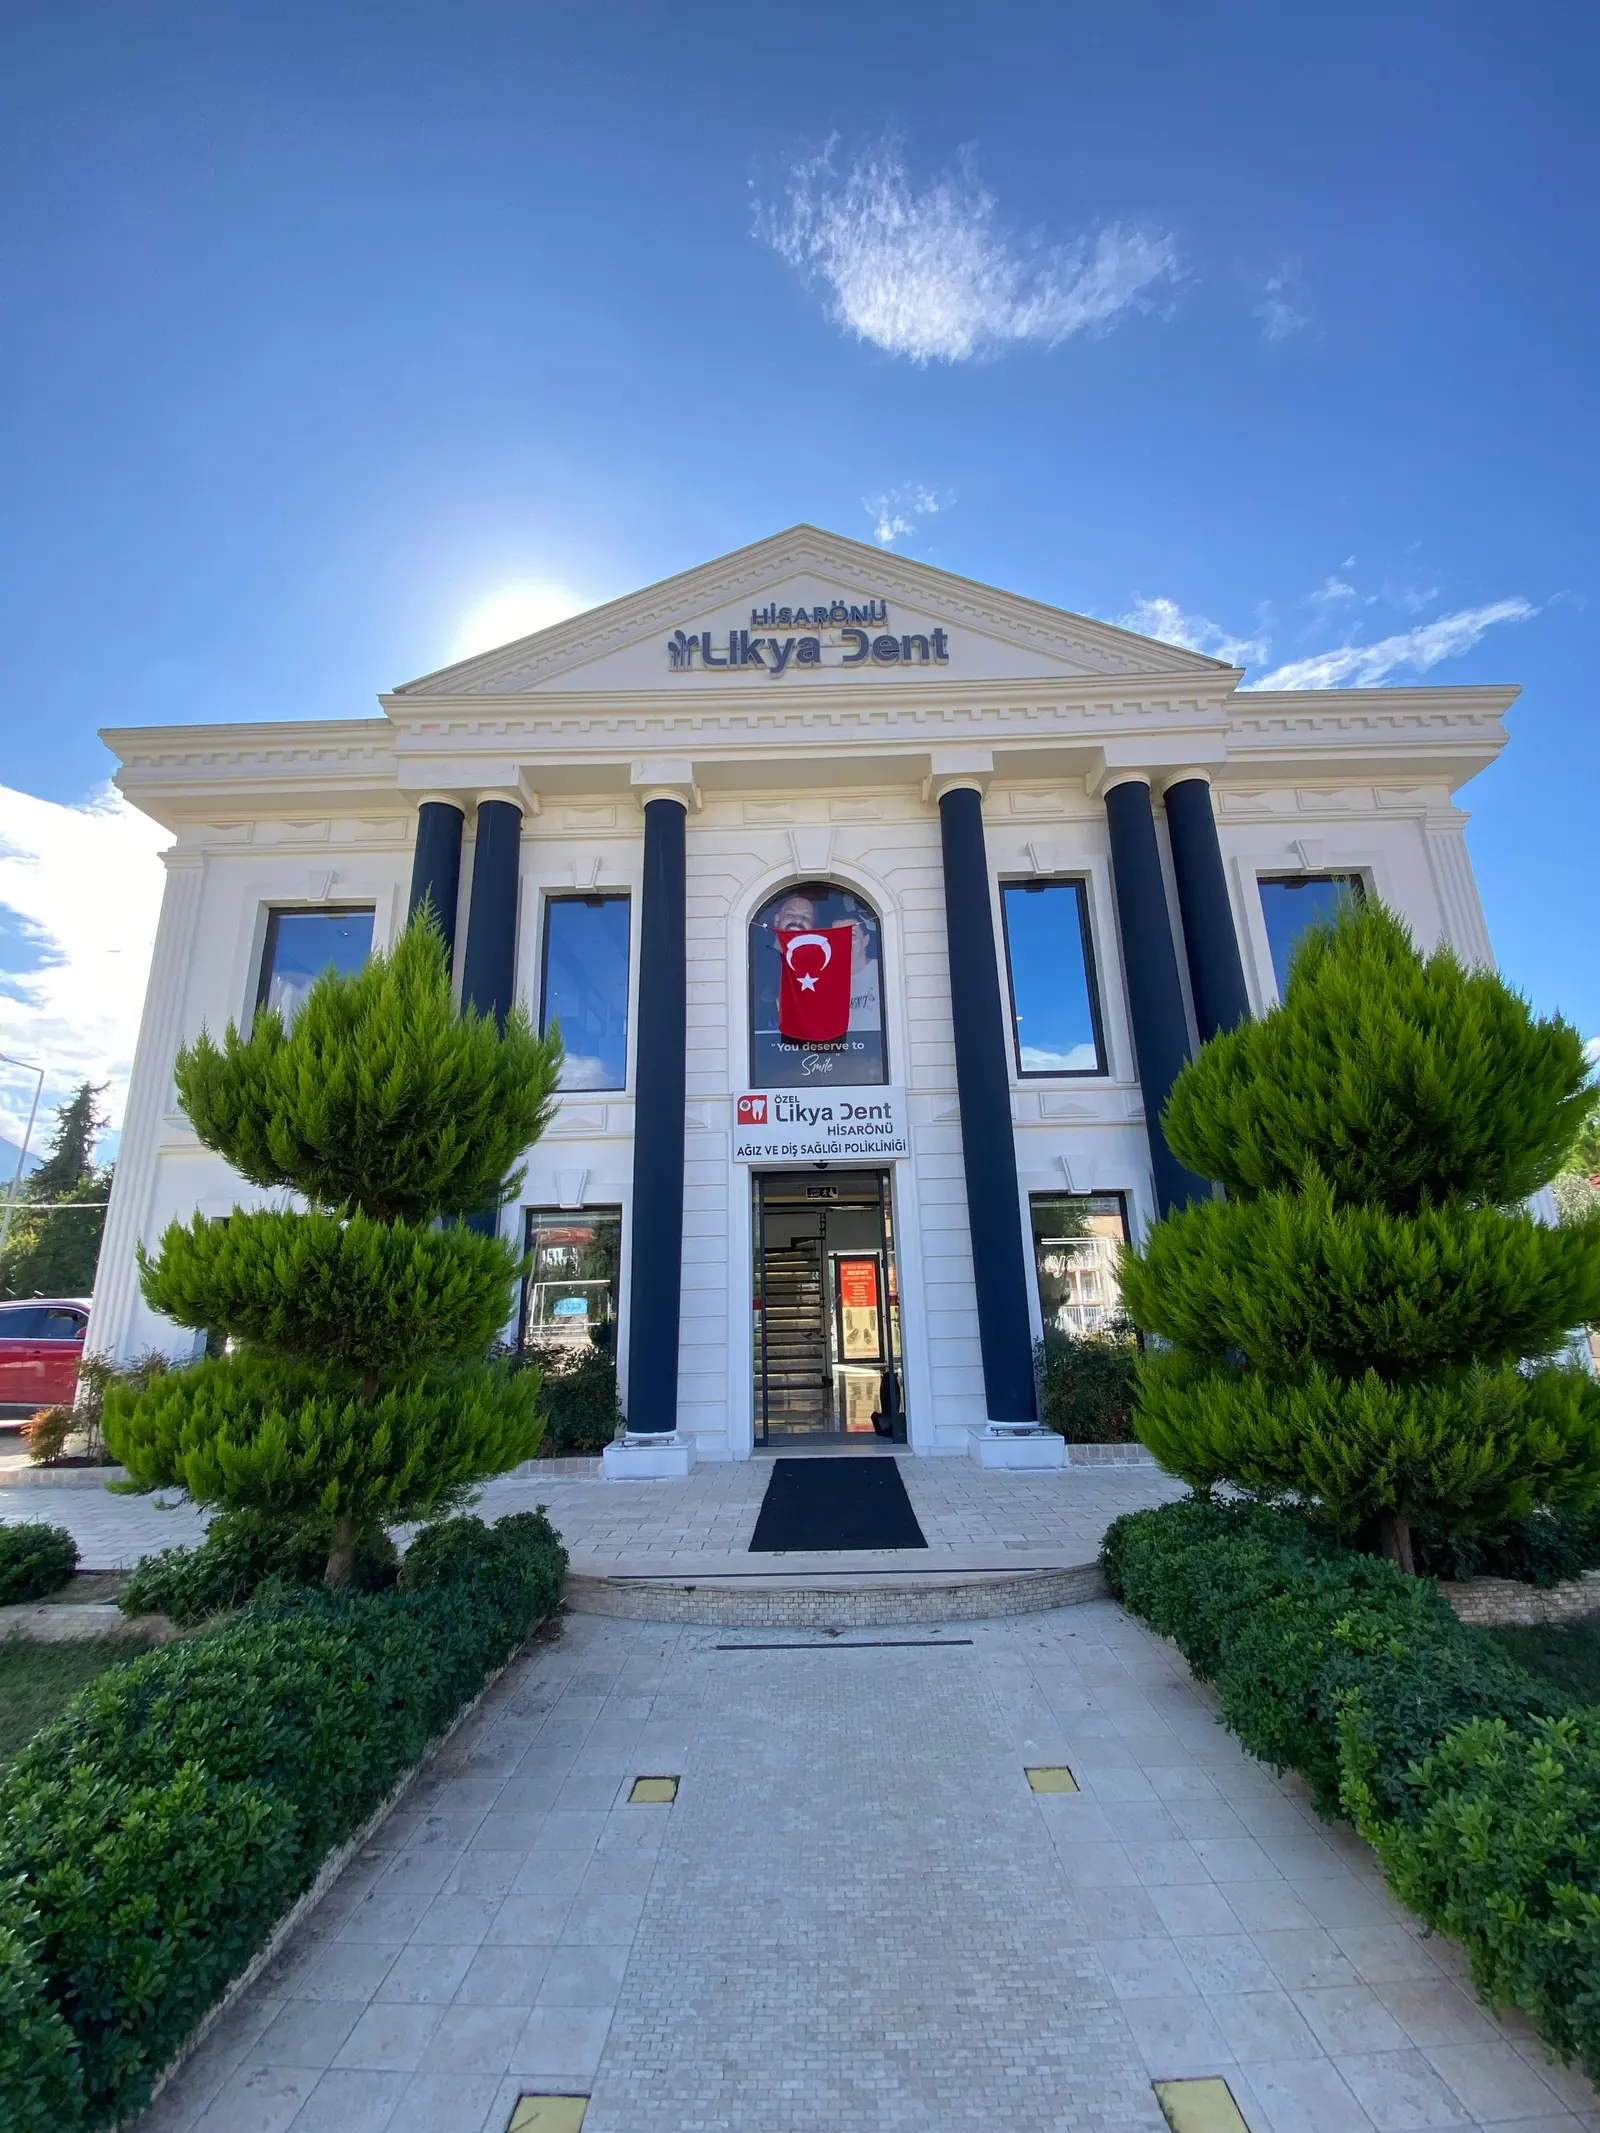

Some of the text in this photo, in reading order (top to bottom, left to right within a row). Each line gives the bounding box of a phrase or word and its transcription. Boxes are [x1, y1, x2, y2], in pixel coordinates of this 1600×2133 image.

[751, 600, 888, 626] HİSARÖNÜ
[701, 627, 950, 676] Likya Dent
[802, 1041, 849, 1051] deserve
[852, 1041, 865, 1050] to
[774, 1094, 800, 1104] ÖZEL
[775, 1102, 892, 1126] Likya Dent
[827, 1122, 894, 1136] HİSARÖNÜ
[737, 1138, 907, 1157] AĞIZ VE DİŞ SAĞLIĞI POLİKLİNİĞİ
